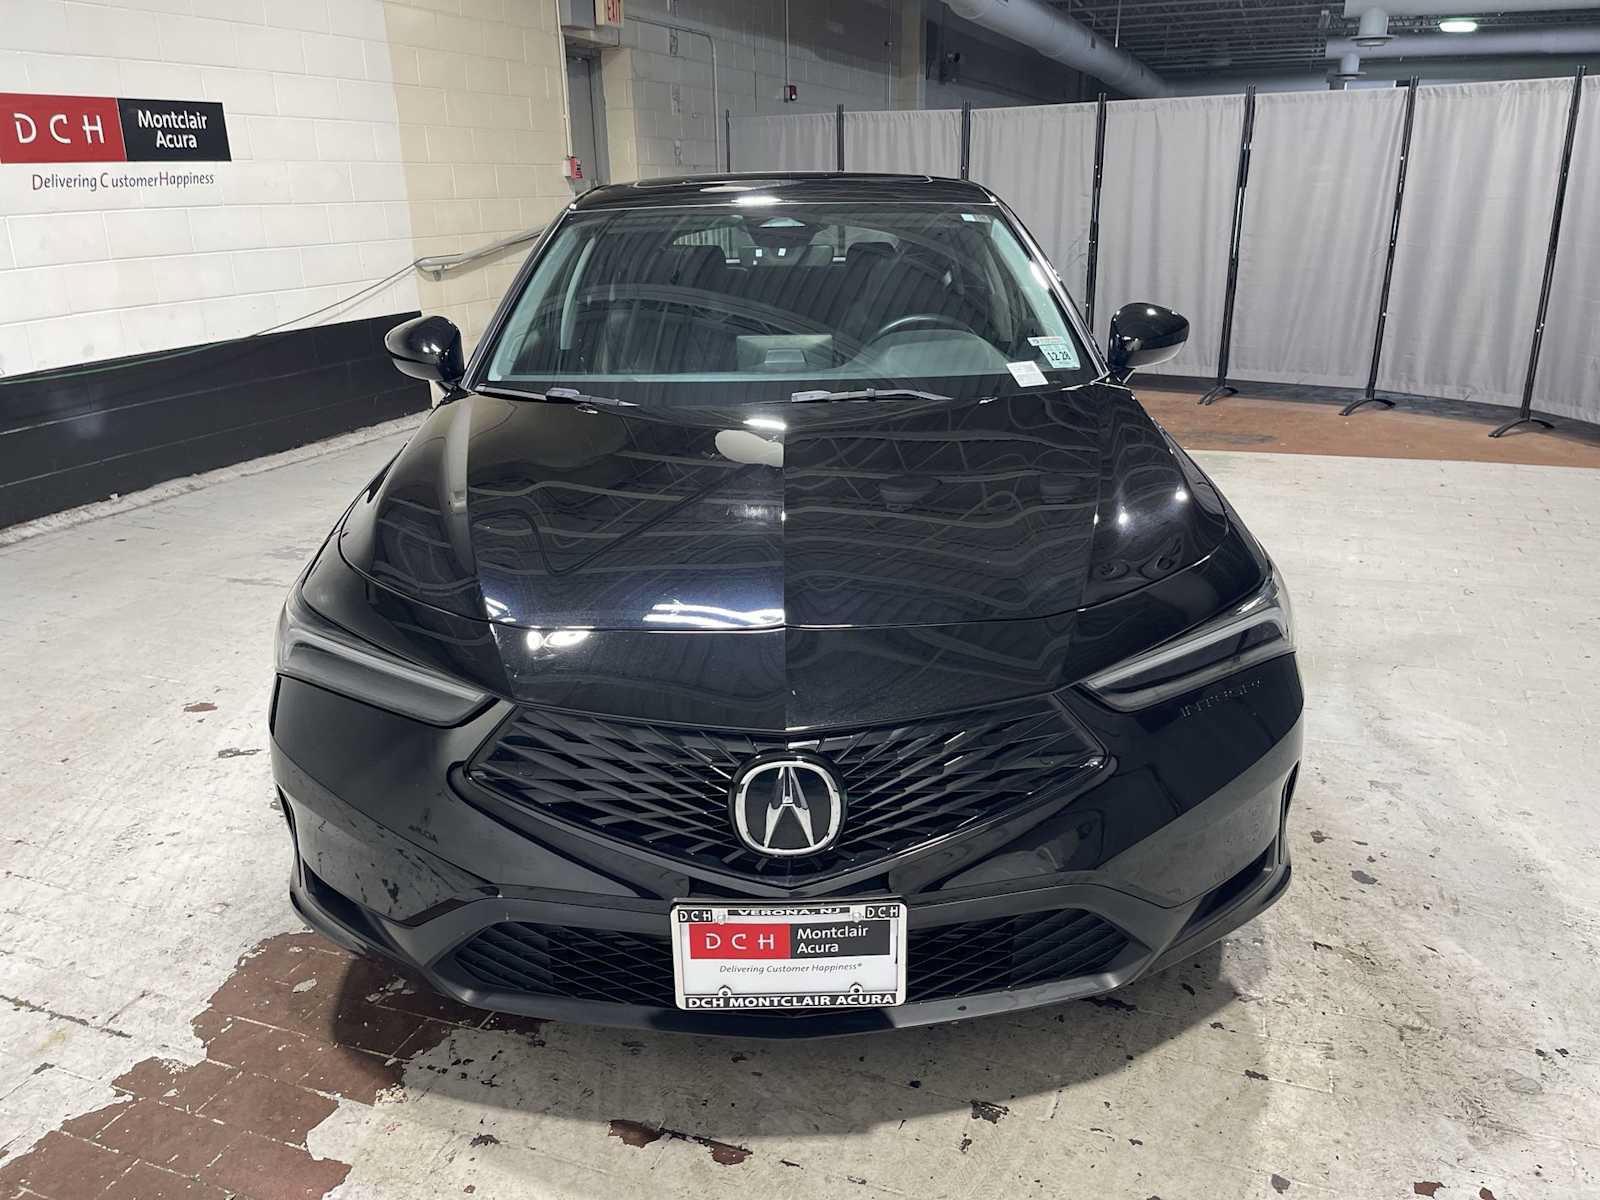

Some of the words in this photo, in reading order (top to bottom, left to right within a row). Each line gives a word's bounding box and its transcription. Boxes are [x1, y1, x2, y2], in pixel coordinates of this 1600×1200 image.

[137, 109, 208, 130] Montclair
[13, 113, 105, 144] DCH
[155, 130, 198, 149] Acura
[32, 173, 97, 192] Delivering
[679, 910, 712, 923] DCH
[820, 907, 841, 915] NJ
[865, 906, 900, 918] DCH
[796, 925, 870, 940] Montclair
[705, 932, 775, 950] DCH
[796, 942, 840, 954] Acura
[719, 964, 765, 975] Delivering
[767, 964, 810, 973] Customer
[688, 997, 724, 1008] DCH
[729, 995, 831, 1008] MONTCLAIR
[836, 994, 894, 1005] ACURA
